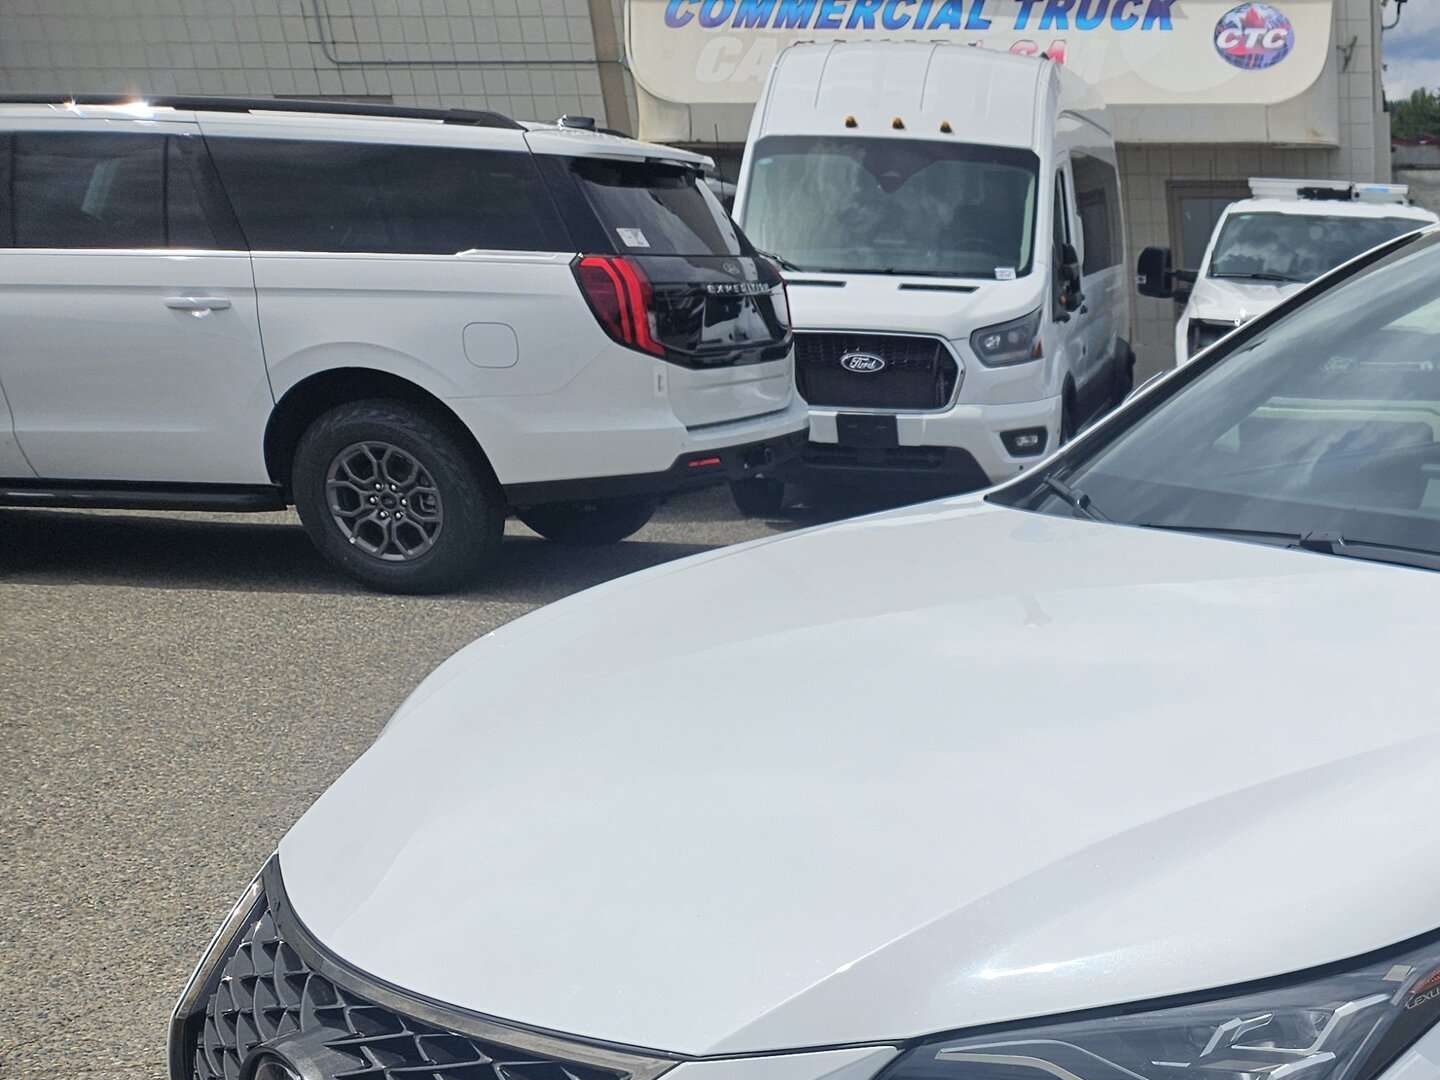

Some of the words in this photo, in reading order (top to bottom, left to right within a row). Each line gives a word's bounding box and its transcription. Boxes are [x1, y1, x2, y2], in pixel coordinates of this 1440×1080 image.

[664, 0, 992, 30] COMMERCIAL
[1013, 0, 1176, 31] TRUCK
[1217, 28, 1288, 48] CTC
[848, 356, 877, 369] Ford
